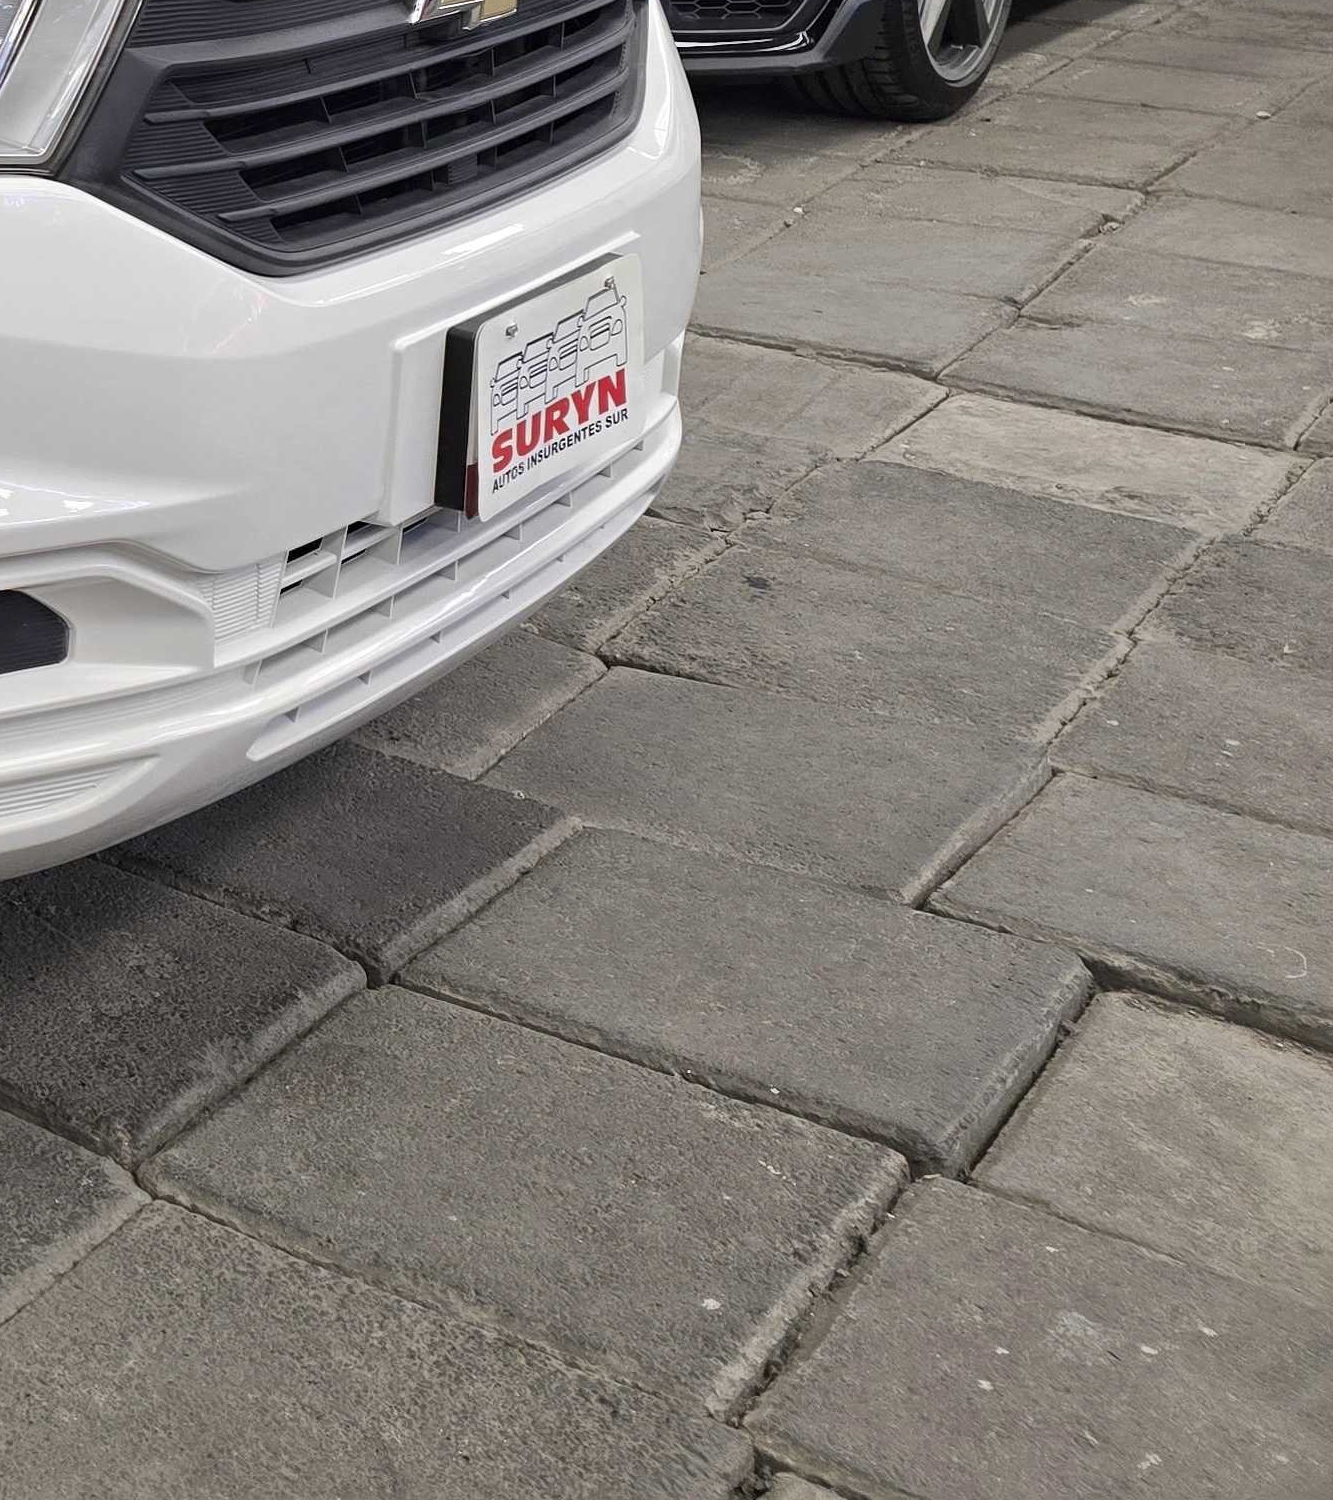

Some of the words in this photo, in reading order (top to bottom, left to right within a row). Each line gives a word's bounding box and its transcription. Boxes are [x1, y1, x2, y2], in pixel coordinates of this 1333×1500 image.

[491, 368, 627, 473] SURYN
[491, 461, 525, 494] AUTOS
[527, 420, 603, 471] INSURGENTES
[605, 408, 629, 429] SUR
